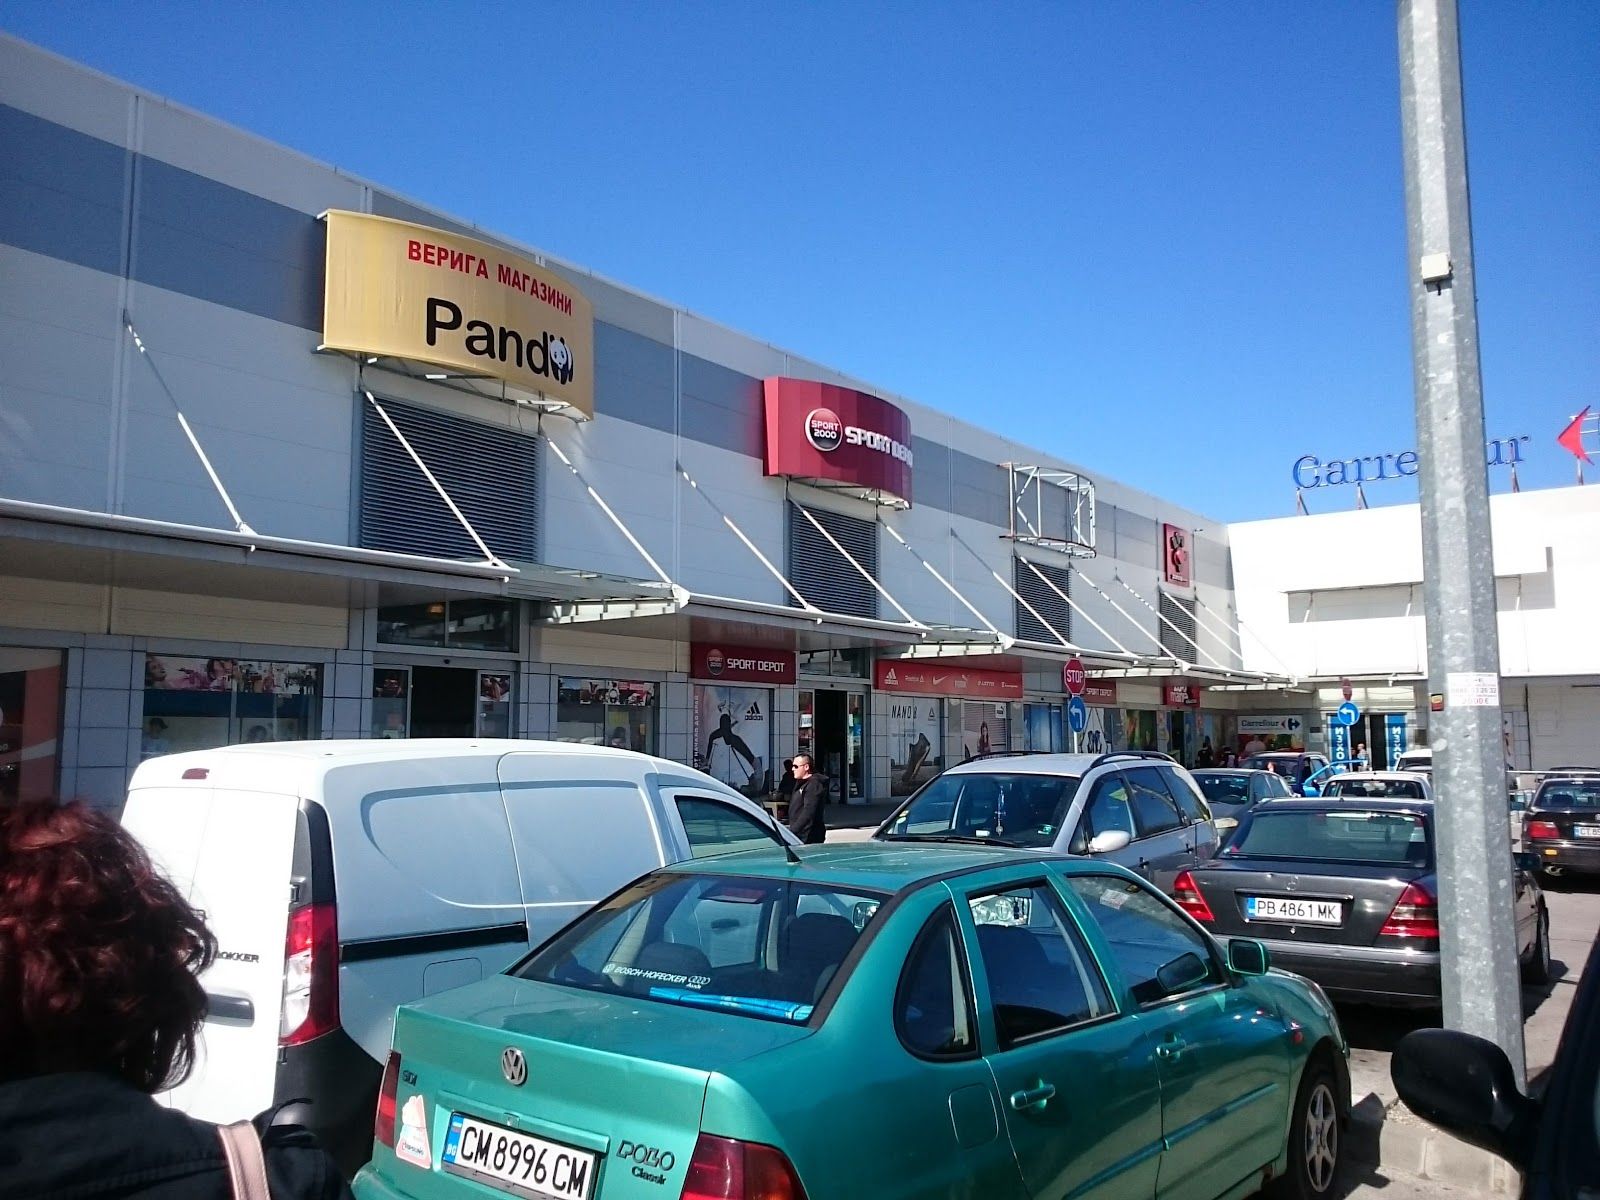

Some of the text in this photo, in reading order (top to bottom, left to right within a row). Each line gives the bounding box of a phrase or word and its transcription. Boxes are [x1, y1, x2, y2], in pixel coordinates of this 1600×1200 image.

[408, 239, 572, 315] ВЕРИГА МАГАЗИНИ
[811, 420, 839, 430] SPORT
[813, 428, 837, 439] 2000
[845, 426, 892, 454] SPORT
[1292, 434, 1531, 490] Carreur
[727, 658, 785, 673] SPORT DEPOT
[1066, 669, 1084, 683] STOP
[1257, 900, 1337, 920] PB 4861 MK
[216, 951, 260, 963] OKKER
[461, 1126, 588, 1198] CM 8996 CM
[616, 1139, 676, 1172] POLO
